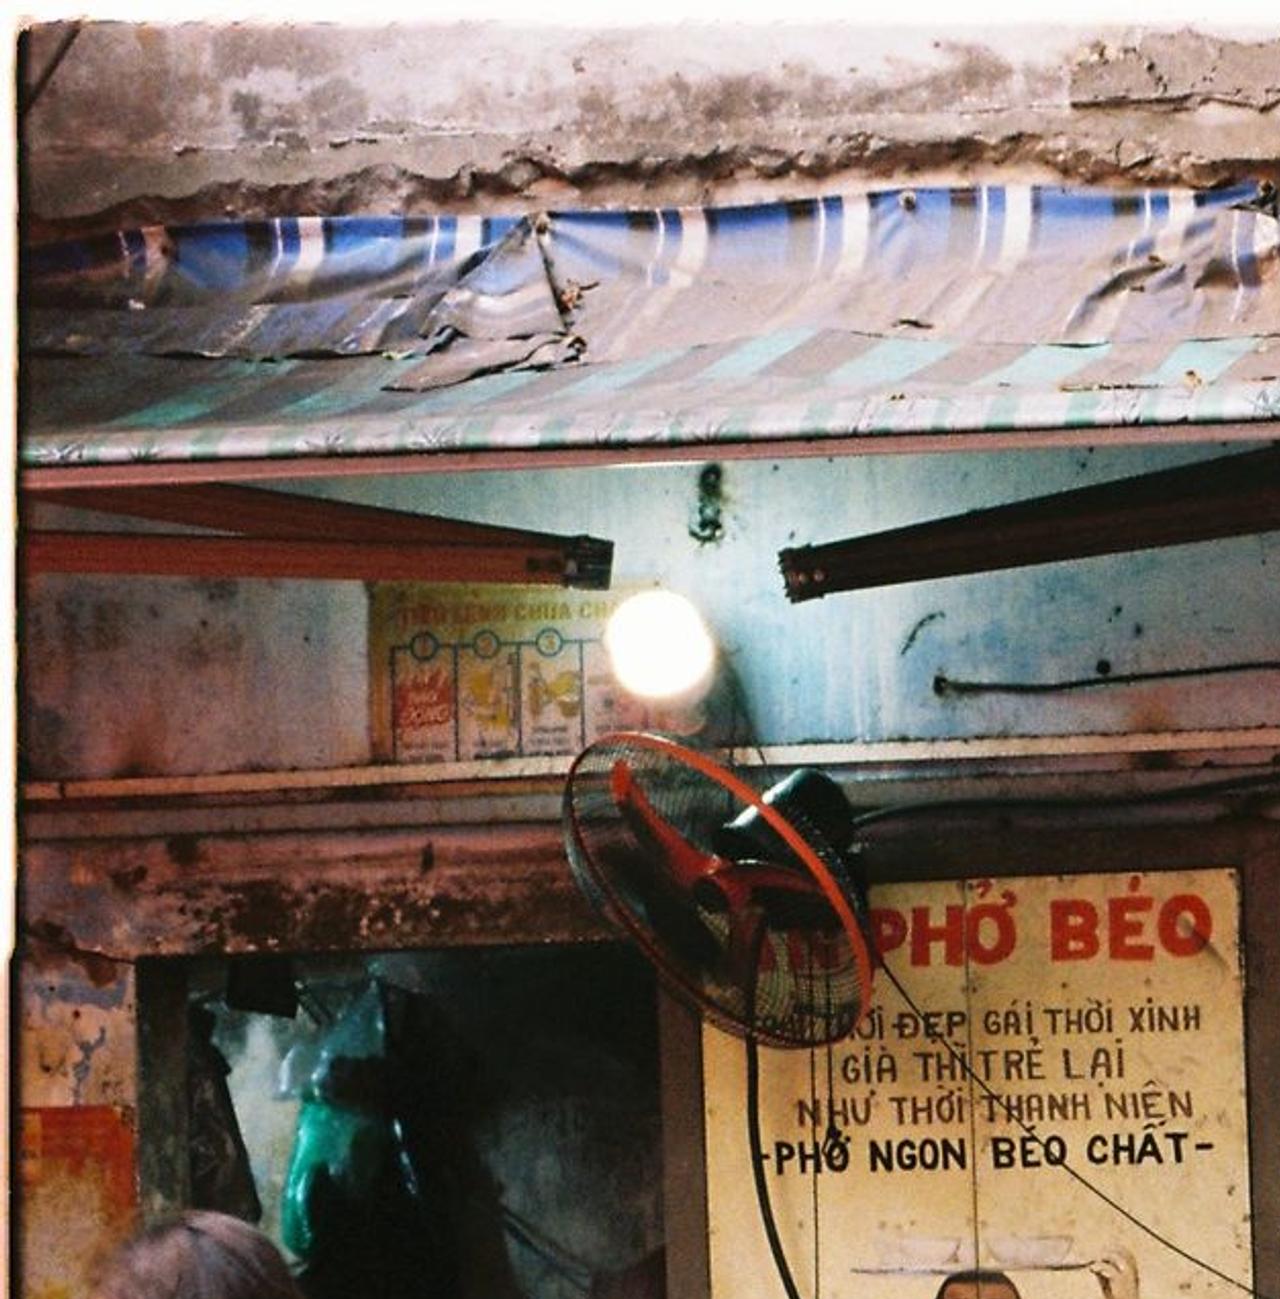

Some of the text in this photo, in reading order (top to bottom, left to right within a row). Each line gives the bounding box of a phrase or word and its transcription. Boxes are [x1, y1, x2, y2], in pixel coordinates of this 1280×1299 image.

[870, 878, 1017, 967] PHỞ
[1051, 875, 1213, 962] BÉO
[892, 1009, 967, 1044] ĐẸP
[984, 1000, 1034, 1036] GÁI
[1043, 998, 1113, 1036] THỜI
[1128, 997, 1201, 1033] XINH
[841, 1046, 898, 1084] GIÀ
[977, 1036, 1046, 1081] TRẺ
[1063, 1037, 1125, 1088] LẠI
[797, 1080, 1194, 1127] NHƯ THỜI THANH NIÊN
[869, 1137, 968, 1172] NGON
[992, 1126, 1068, 1170] BÉO
